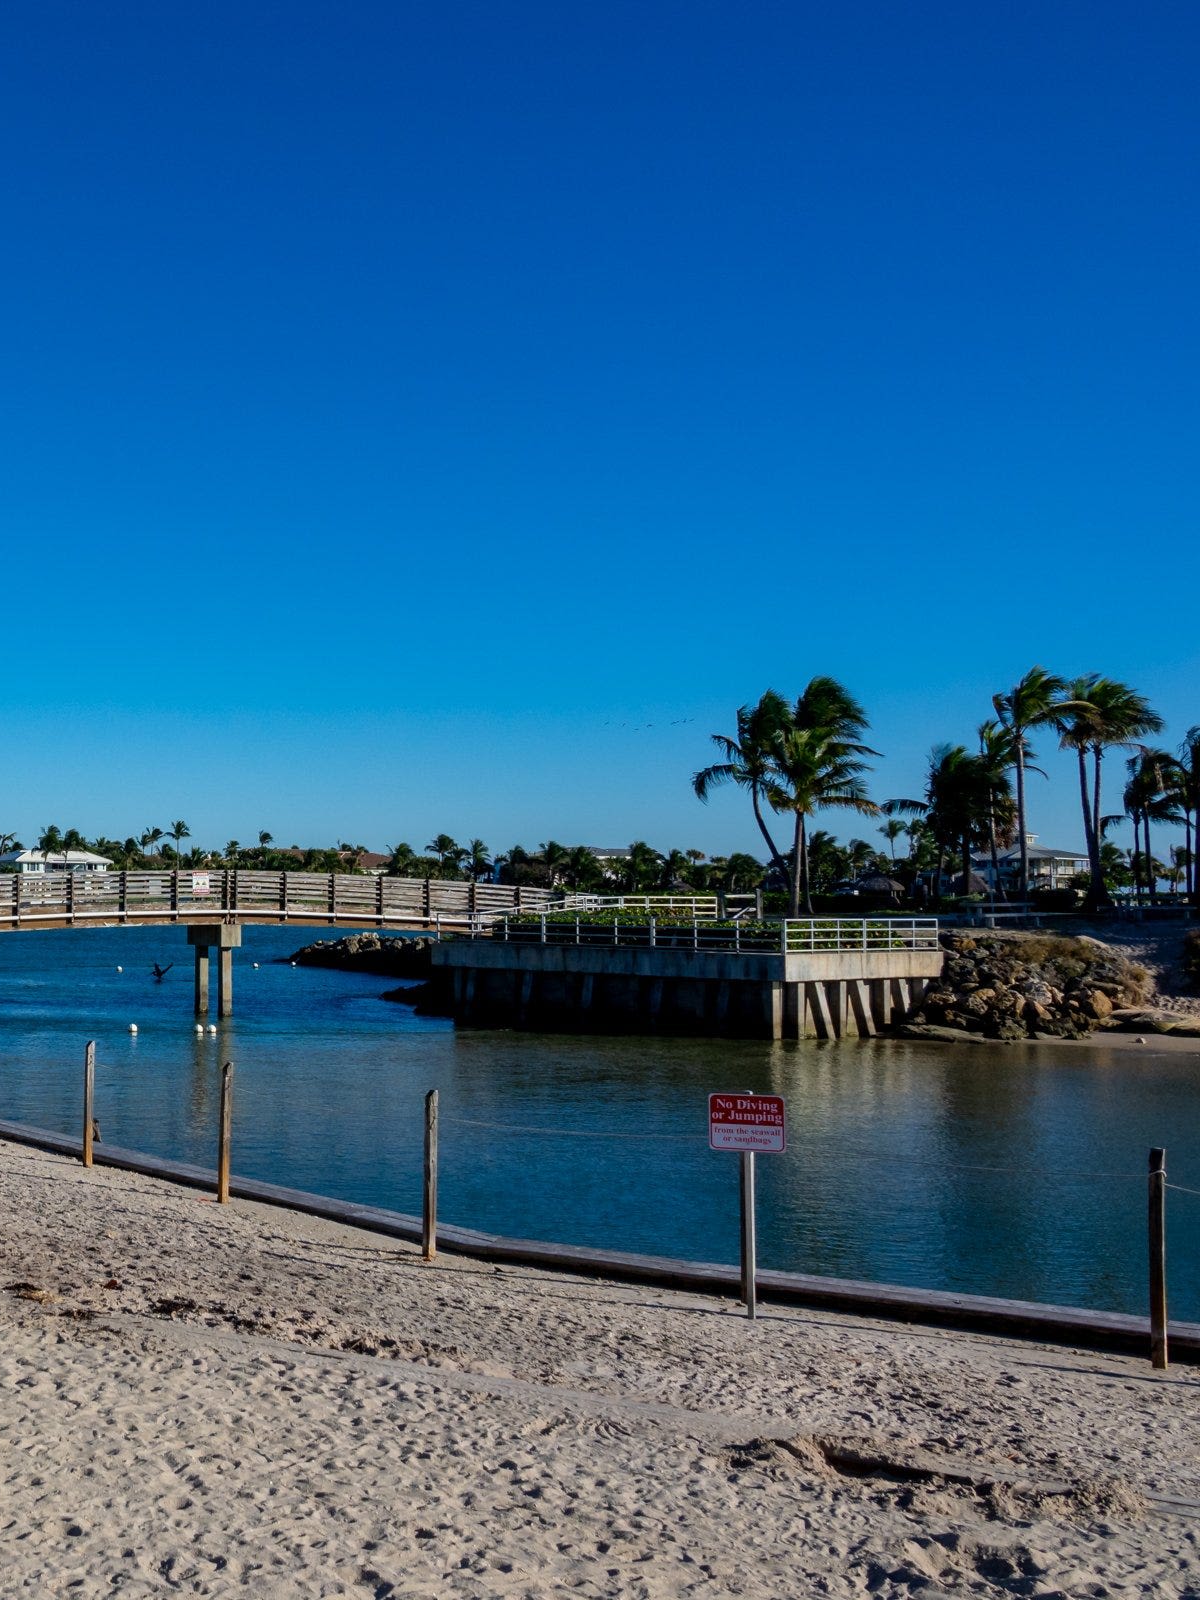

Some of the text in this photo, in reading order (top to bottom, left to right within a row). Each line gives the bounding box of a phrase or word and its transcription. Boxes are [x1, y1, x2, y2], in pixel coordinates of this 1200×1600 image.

[716, 1098, 778, 1113] No Diving
[712, 1110, 782, 1125] or Jumping
[714, 1126, 734, 1134] from
[736, 1127, 748, 1135] the
[734, 1136, 772, 1145] sandbags
